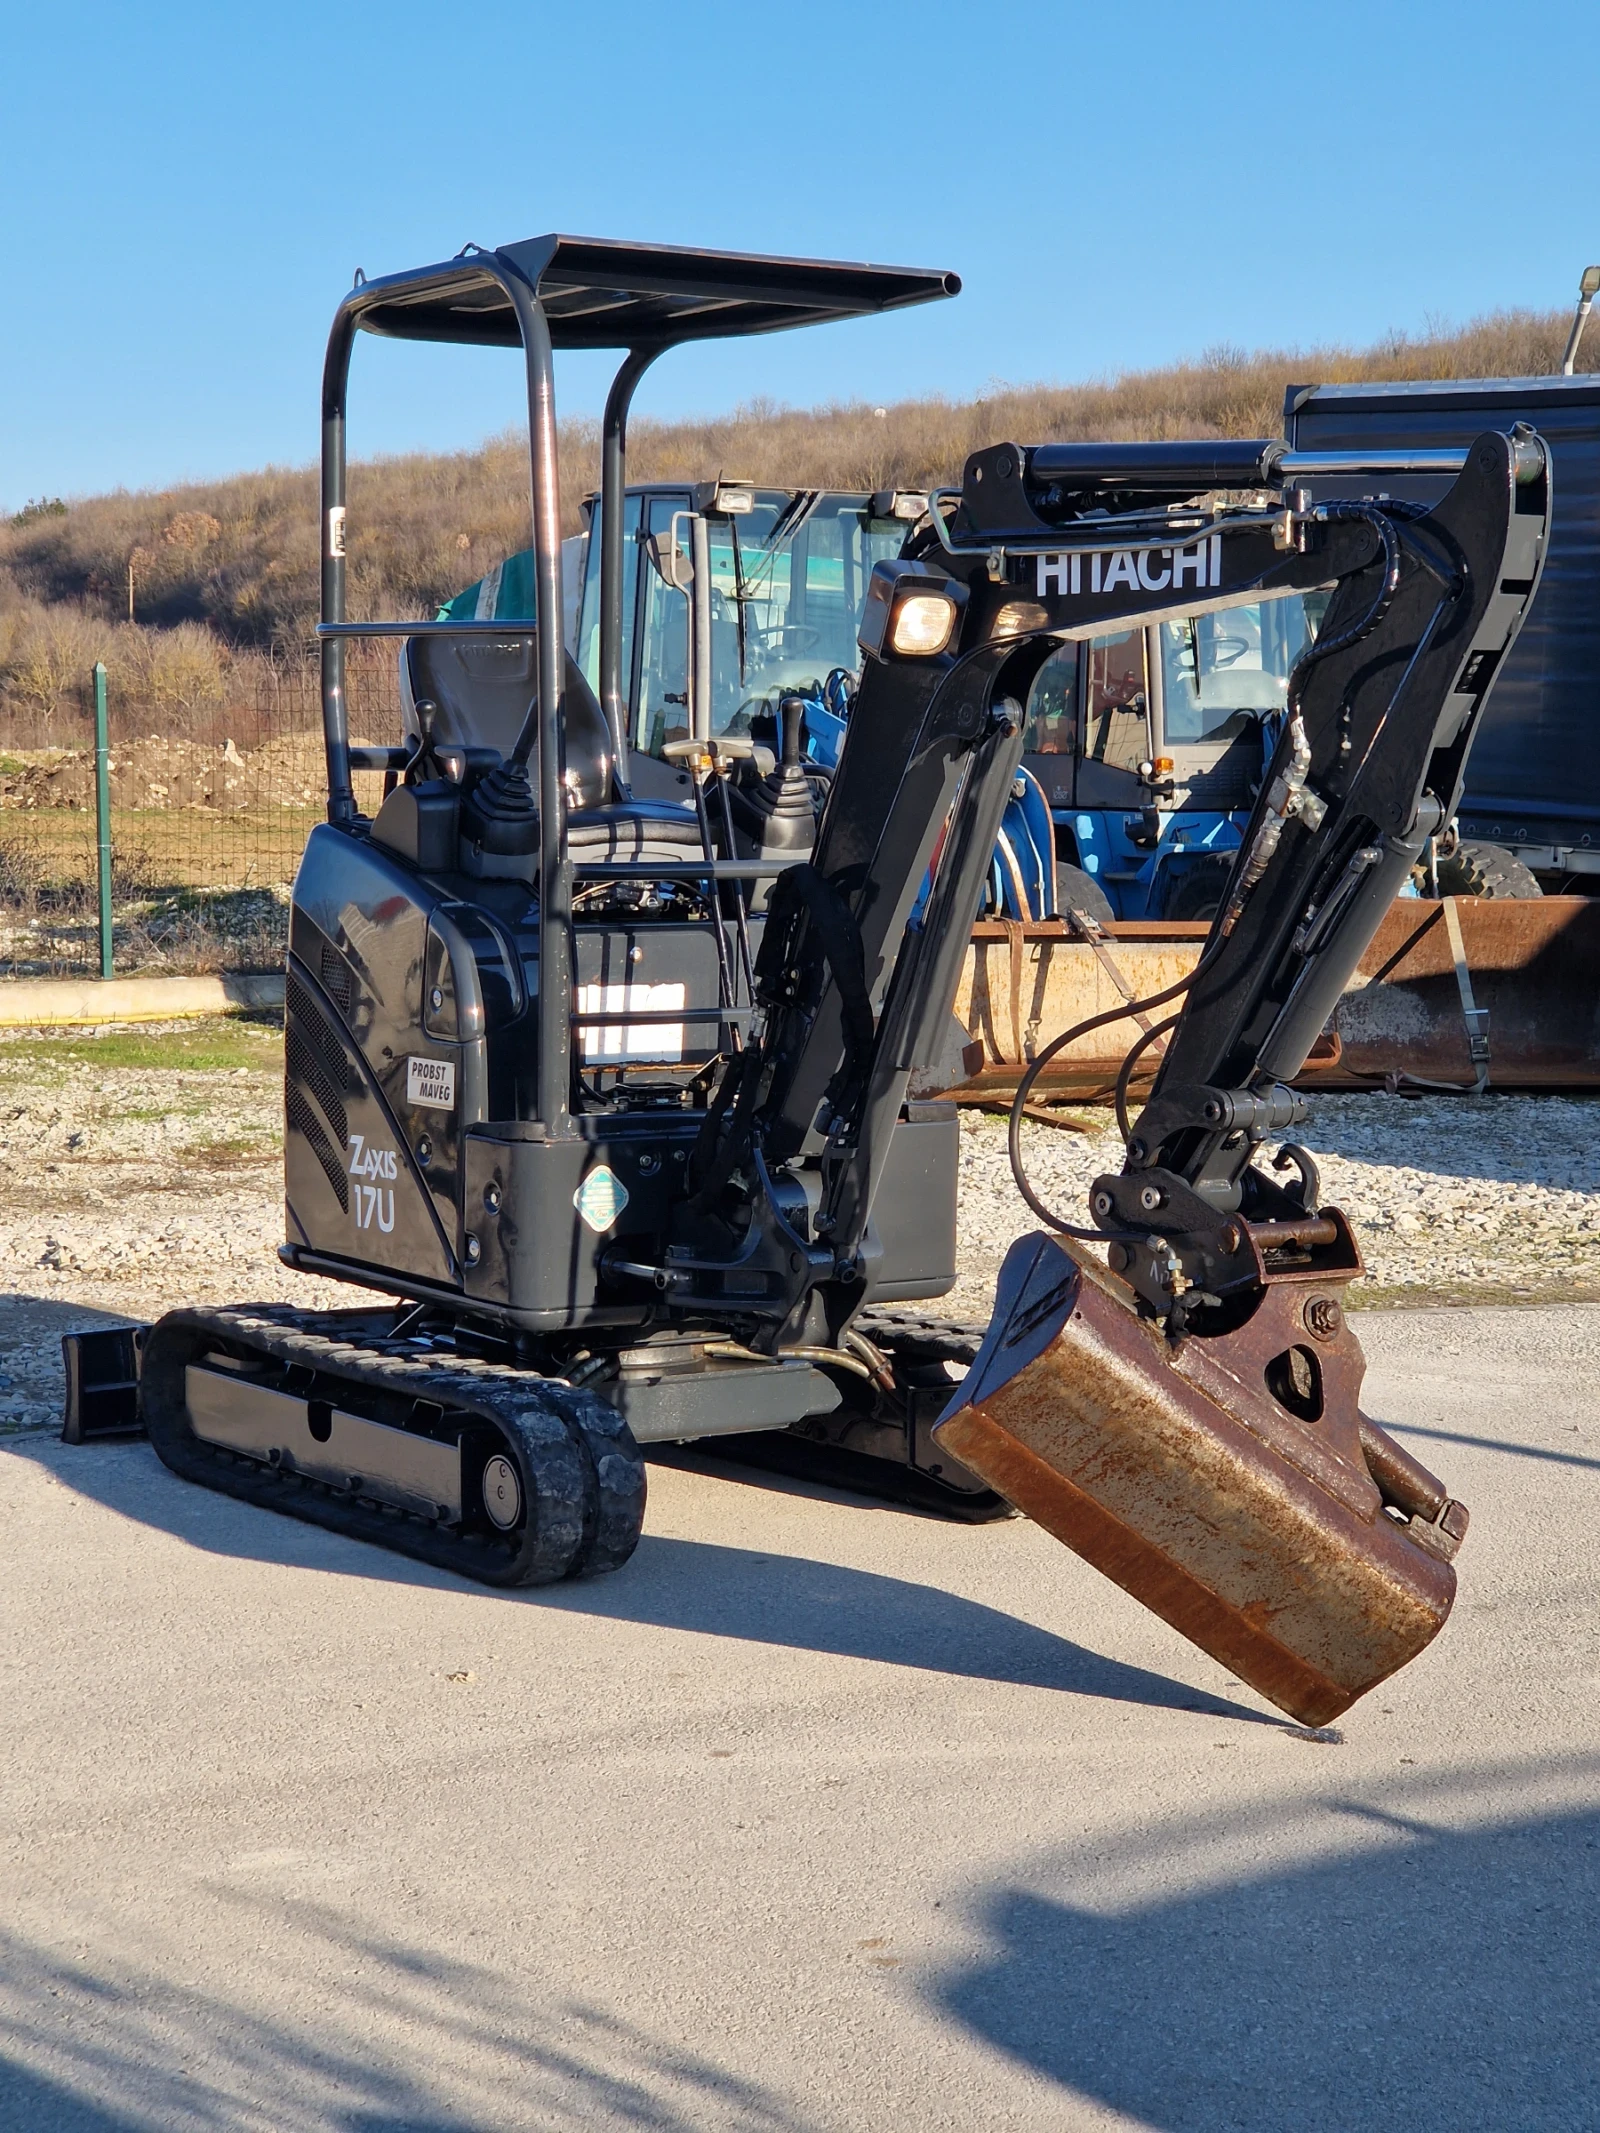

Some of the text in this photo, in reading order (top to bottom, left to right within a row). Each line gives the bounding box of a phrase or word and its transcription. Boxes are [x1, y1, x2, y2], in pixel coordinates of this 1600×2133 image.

[1037, 535, 1221, 597] HITACHI
[412, 1062, 446, 1081] PROBST
[420, 1082, 450, 1101] MAVEG
[354, 1184, 395, 1233] 17U
